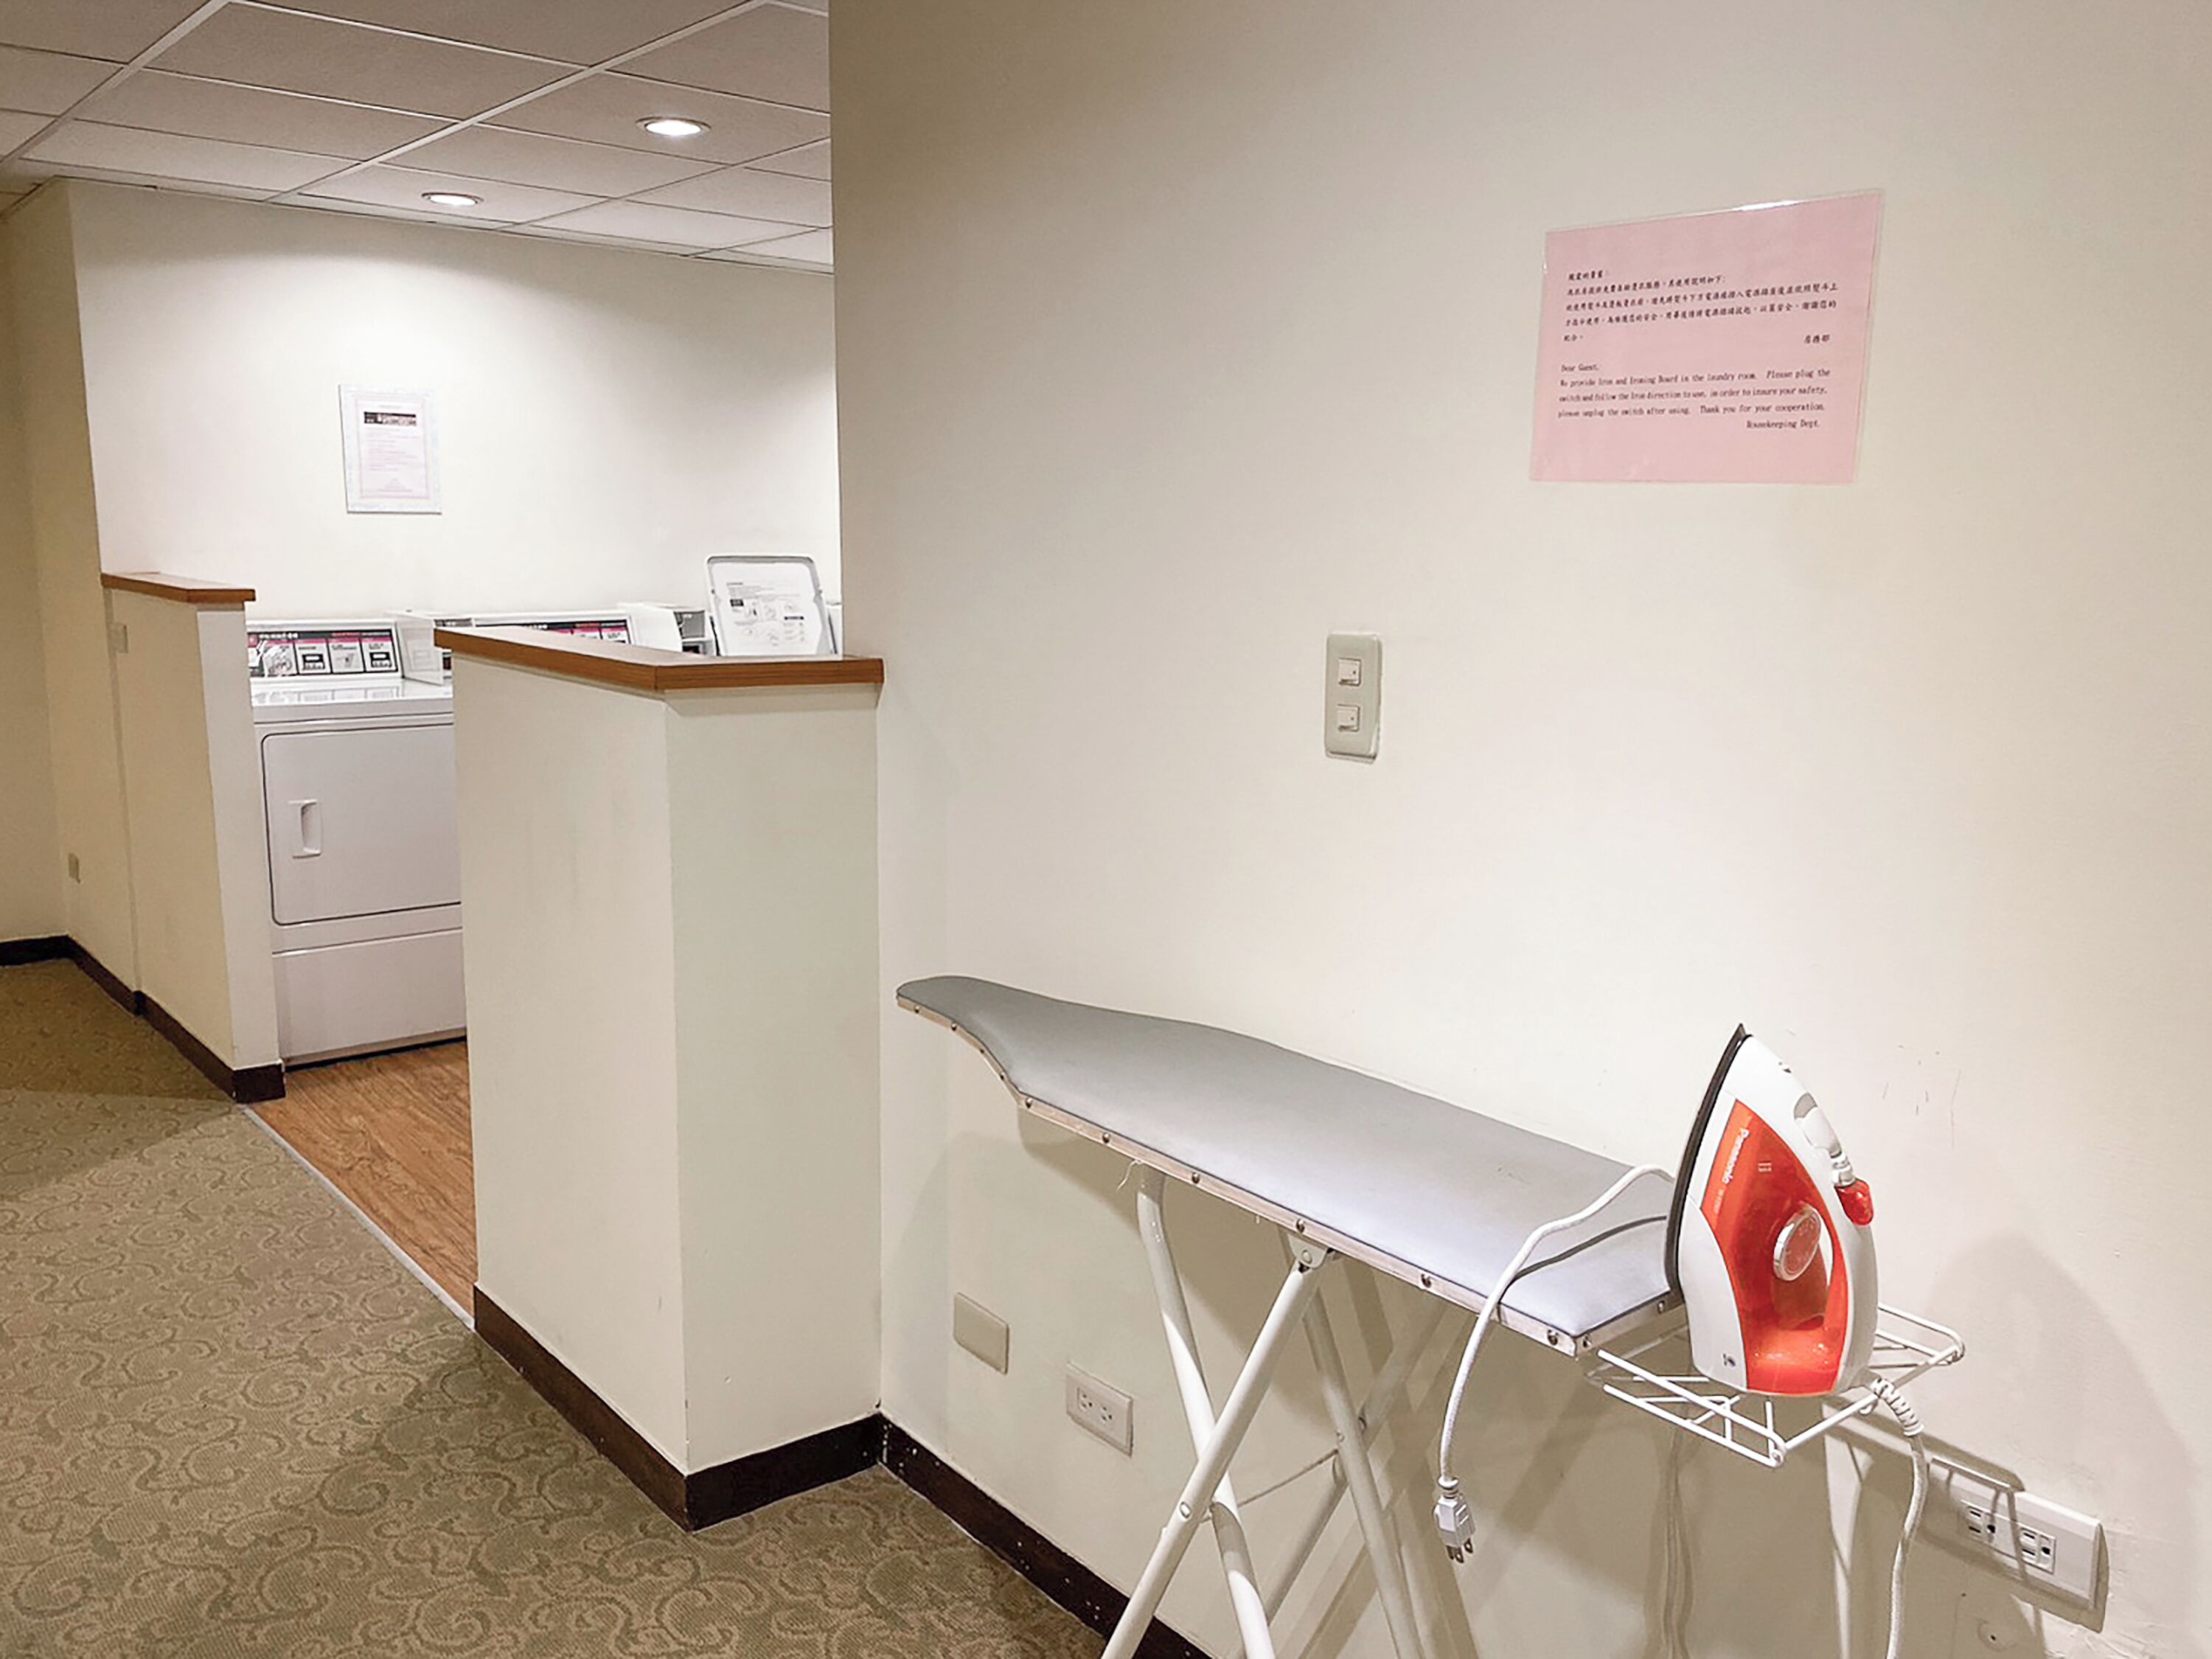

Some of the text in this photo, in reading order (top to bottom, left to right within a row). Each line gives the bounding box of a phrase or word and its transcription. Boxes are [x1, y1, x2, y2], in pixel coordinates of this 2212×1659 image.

[1561, 364, 1576, 372] Dear
[1571, 379, 1596, 388] provide
[1658, 375, 1677, 383] Board
[1691, 374, 1704, 382] the
[1707, 373, 1734, 382] laundry
[1767, 370, 1792, 378] Please
[1795, 369, 1814, 379] plug
[1818, 369, 1830, 377] the
[1595, 393, 1615, 401] follow
[1779, 388, 1796, 396] your
[1558, 410, 1579, 418] please
[1583, 409, 1604, 418] unplug
[1621, 408, 1644, 416] switch
[1700, 406, 1719, 414] Thank
[1755, 405, 1772, 413] your
[1746, 420, 1820, 429] Housekeeping Dept.
[1722, 1127, 1750, 1184] Panasonic
